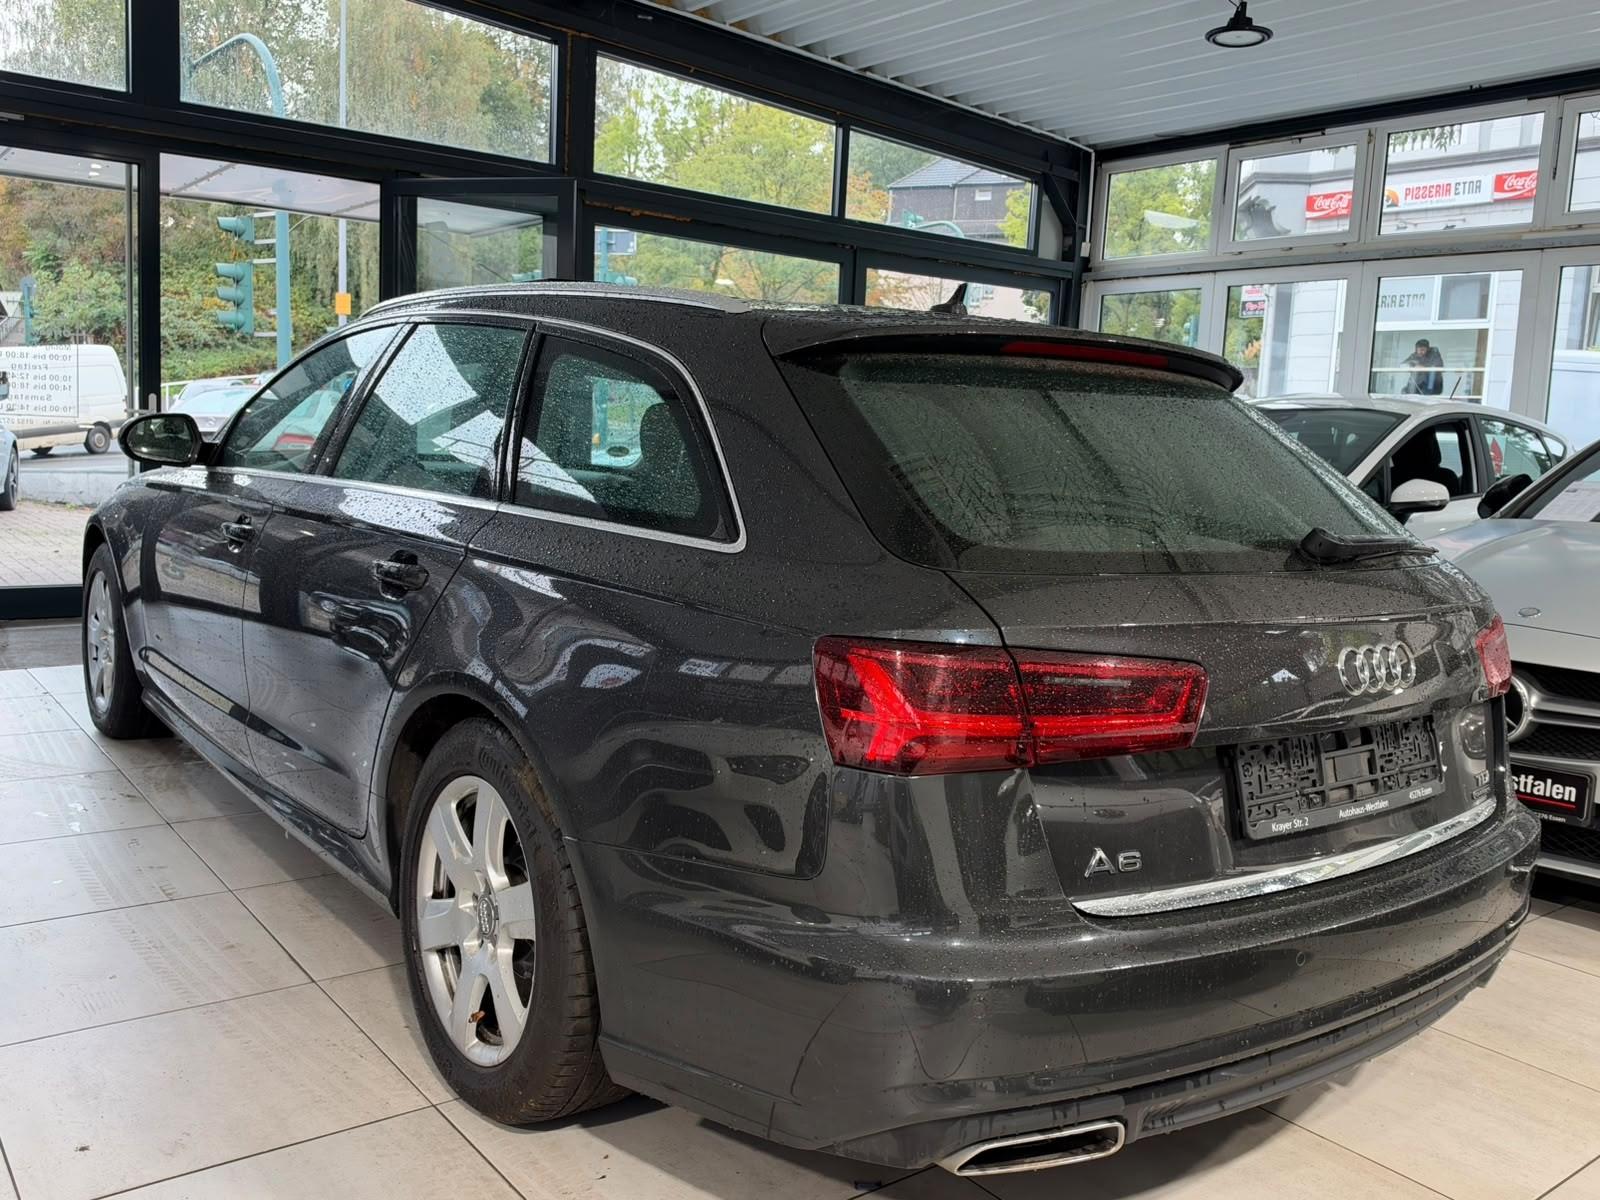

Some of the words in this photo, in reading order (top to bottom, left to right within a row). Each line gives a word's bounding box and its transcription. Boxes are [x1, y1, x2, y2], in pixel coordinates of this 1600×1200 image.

[1404, 183, 1452, 201] PIZZERIA
[1454, 180, 1482, 196] ETNA
[1339, 800, 1389, 818] Autohaus-Westfalen
[1271, 821, 1292, 833] Krayer
[1293, 818, 1304, 828] Str.
[1304, 816, 1309, 826] 2
[1084, 847, 1143, 878] A6
